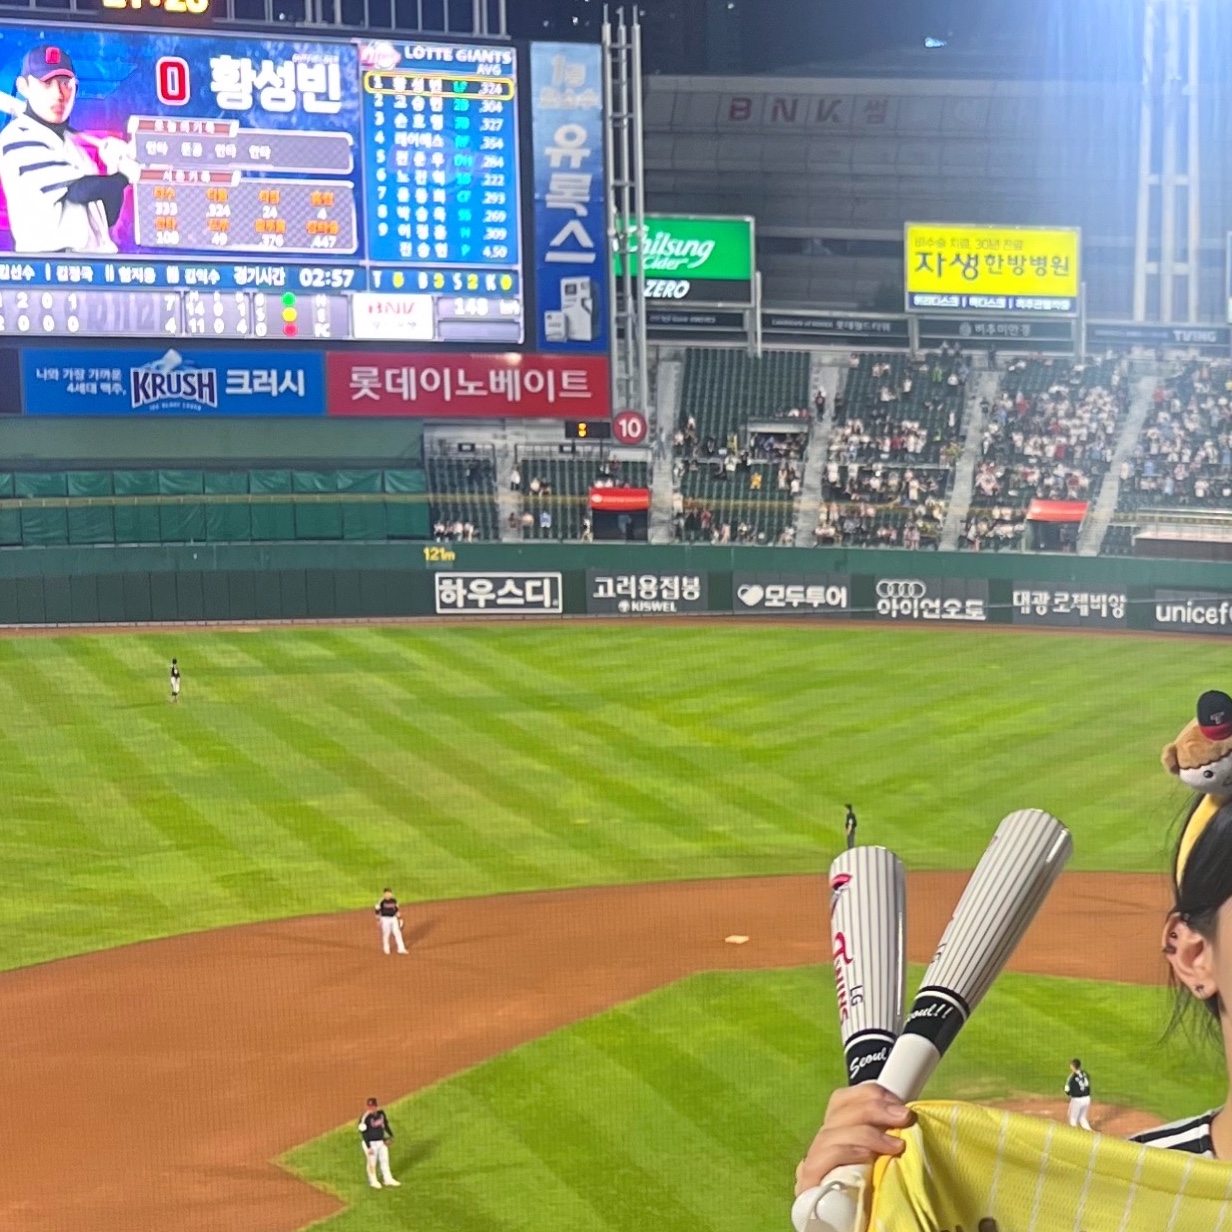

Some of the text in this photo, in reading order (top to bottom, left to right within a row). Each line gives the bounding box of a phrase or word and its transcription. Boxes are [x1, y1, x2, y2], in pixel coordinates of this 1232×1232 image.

[405, 46, 453, 61] LOTTE
[455, 49, 512, 64] GIANTS
[477, 64, 502, 75] AVG
[155, 56, 190, 106] 0
[210, 55, 342, 113] 황성빈
[373, 75, 383, 89] 1
[374, 93, 383, 107] 2
[375, 111, 384, 126] 3
[375, 130, 385, 144] 4
[376, 149, 385, 163] 5
[376, 167, 386, 182] 6
[377, 186, 387, 200] 7
[317, 208, 328, 220] 4
[377, 204, 388, 218] 8
[378, 222, 388, 236] 9
[642, 256, 689, 270] Cider
[914, 252, 1070, 281] 자생한방병원
[233, 266, 286, 286] 경기시간
[299, 268, 354, 288] 02:57
[453, 272, 463, 290] S
[485, 273, 497, 291] K
[643, 279, 690, 298] ZERO
[17, 292, 28, 308] 2
[42, 292, 53, 309] 0
[68, 293, 77, 310] 1
[164, 295, 176, 311] 7
[186, 301, 205, 317] 14
[213, 302, 224, 317] 0
[237, 303, 246, 317] 1
[18, 315, 30, 331] 0
[43, 315, 55, 332] 0
[67, 315, 79, 332] 0
[165, 316, 176, 334] 4
[188, 318, 205, 333] 11
[213, 318, 225, 334] 0
[236, 318, 247, 335] 4
[1172, 329, 1217, 342] TVING
[131, 368, 218, 408] KRUSH
[225, 369, 305, 396] 크러시
[349, 366, 593, 403] 롯데이노베이트
[618, 418, 641, 438] 10
[423, 547, 455, 562] 121m
[593, 575, 700, 601] 고려용접봉
[764, 584, 847, 608] 모두투어
[631, 601, 677, 613] KISWEL
[876, 598, 987, 620] 아이언오토
[1012, 590, 1127, 619] 대광 로제비앙
[1155, 601, 1229, 625] unicef
[850, 984, 864, 1007] LG
